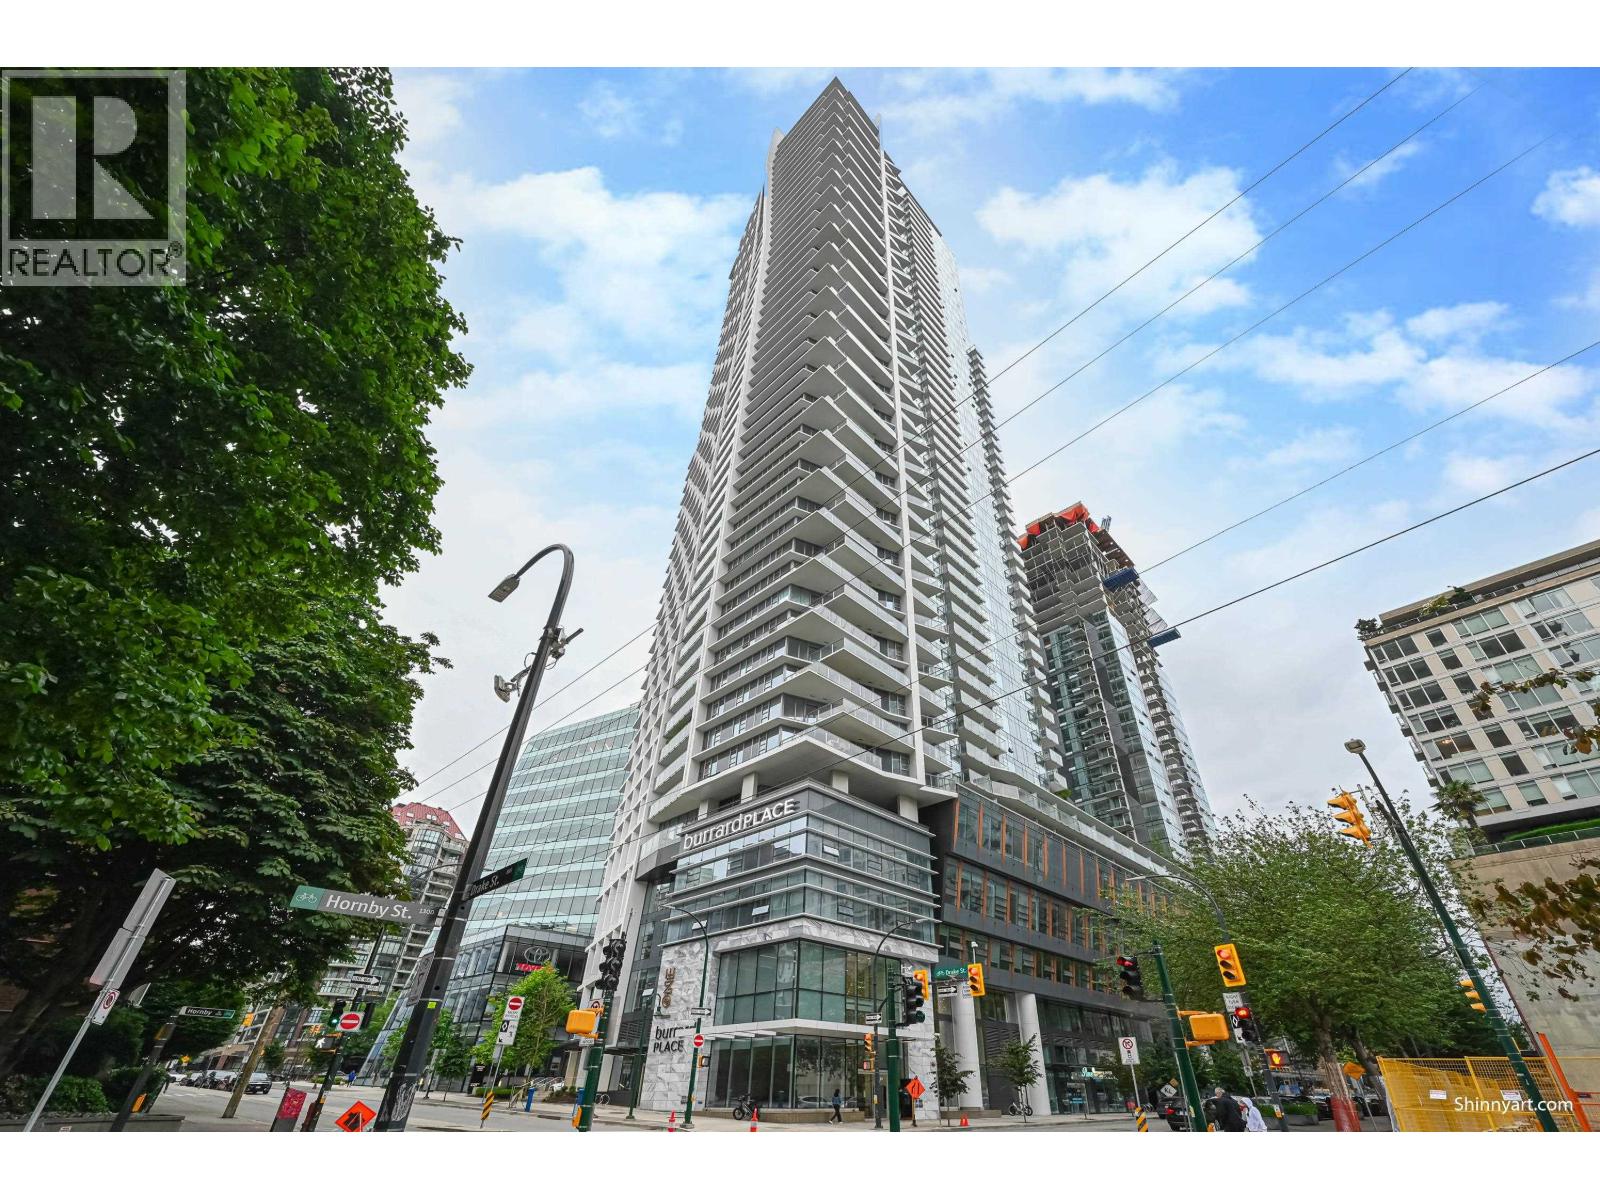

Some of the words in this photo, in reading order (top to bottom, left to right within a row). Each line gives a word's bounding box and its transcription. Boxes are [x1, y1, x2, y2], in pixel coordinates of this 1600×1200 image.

[683, 798, 796, 850] burrardPLACE
[326, 894, 390, 919] Hornby
[390, 904, 413, 920] St.
[187, 1008, 212, 1017] Hornby
[653, 1040, 684, 1054] PLACE
